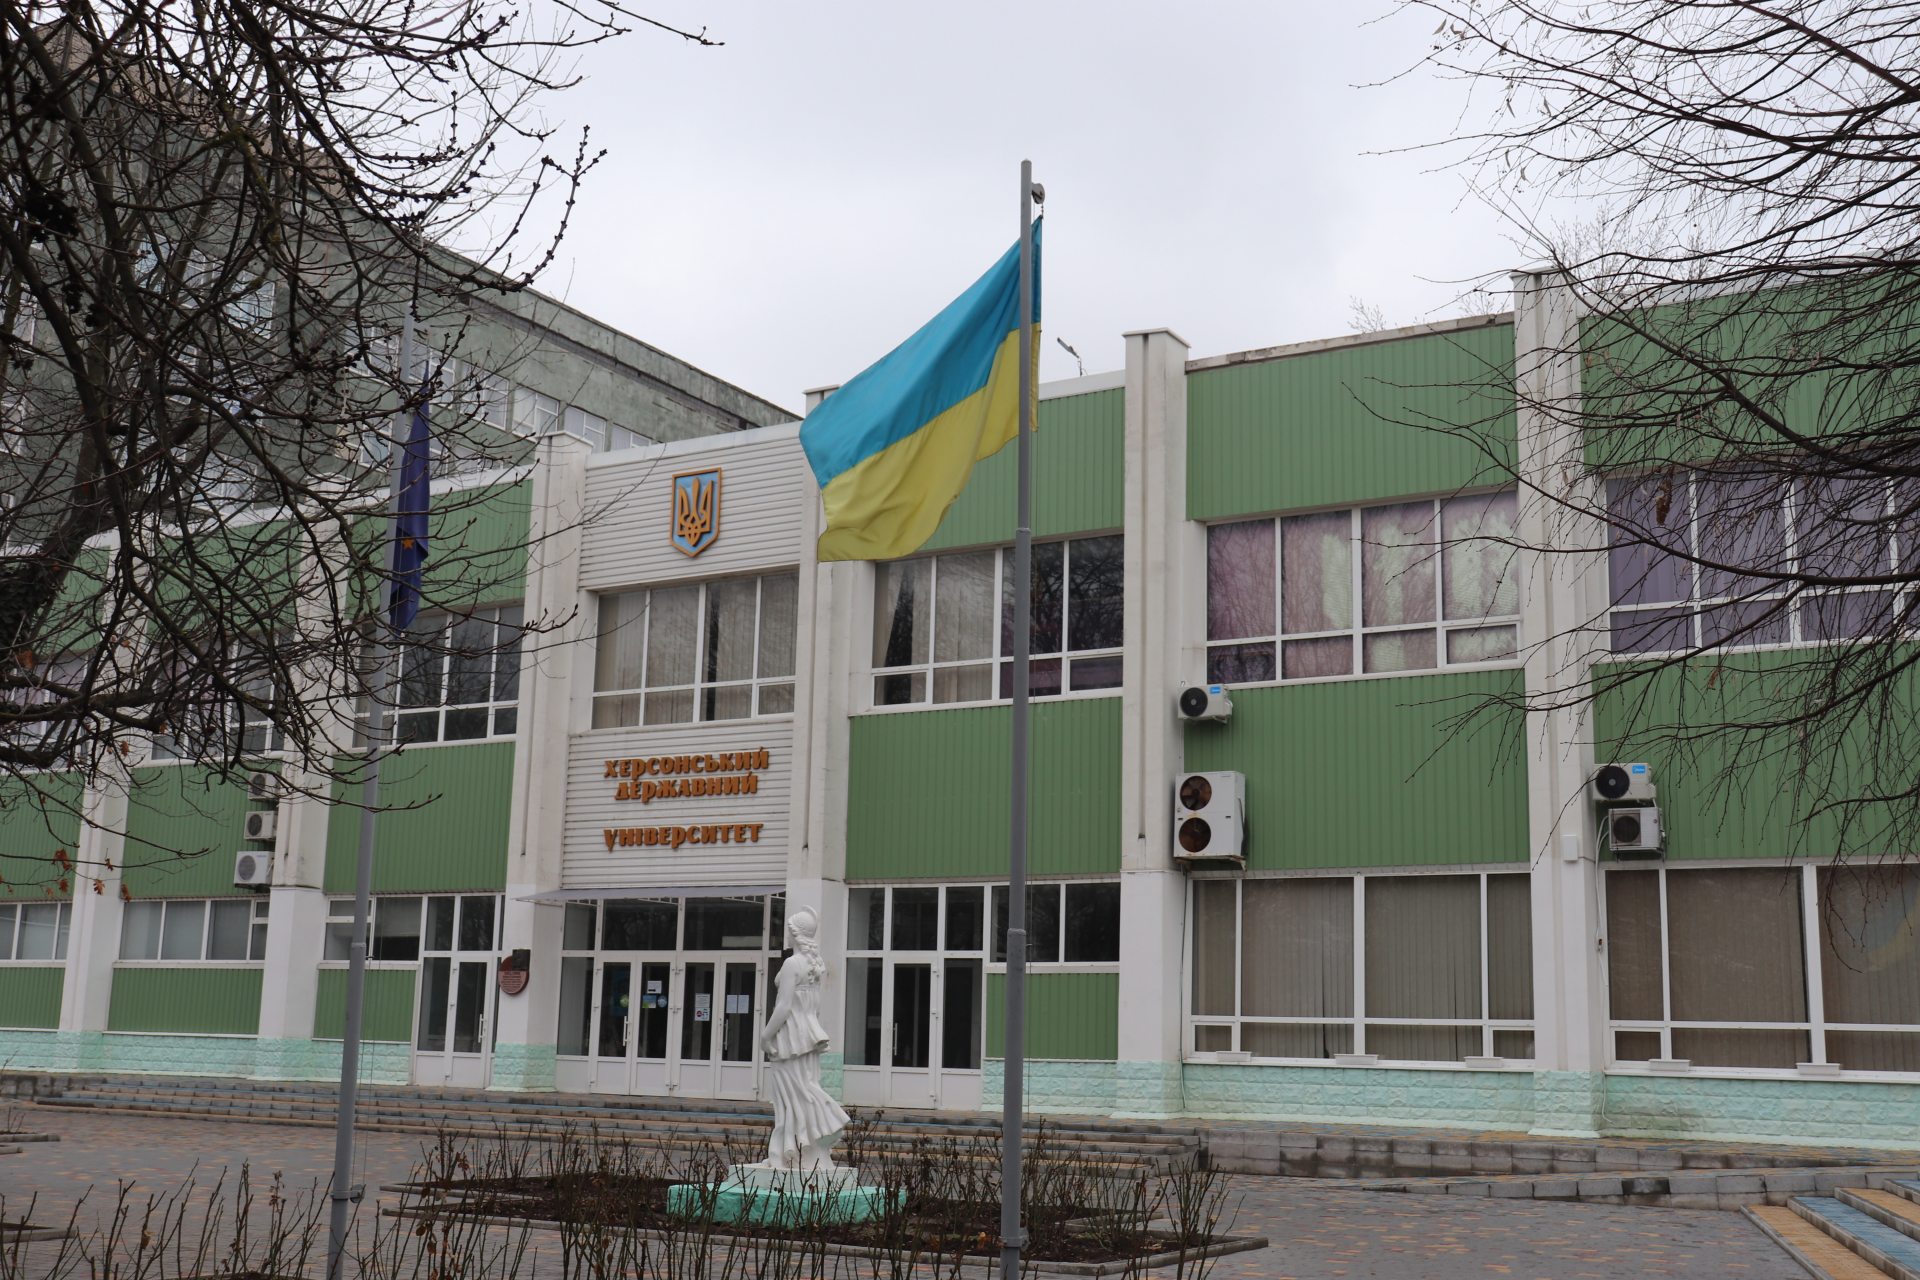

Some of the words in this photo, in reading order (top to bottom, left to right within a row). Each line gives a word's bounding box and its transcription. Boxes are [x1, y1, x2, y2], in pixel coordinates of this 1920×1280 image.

[604, 746, 769, 780] ХЕРСОНСЬКИЙ
[615, 771, 758, 804] ДЕРЖАВНИЙ
[604, 823, 763, 853] УНІВЕРСИТЕТ
